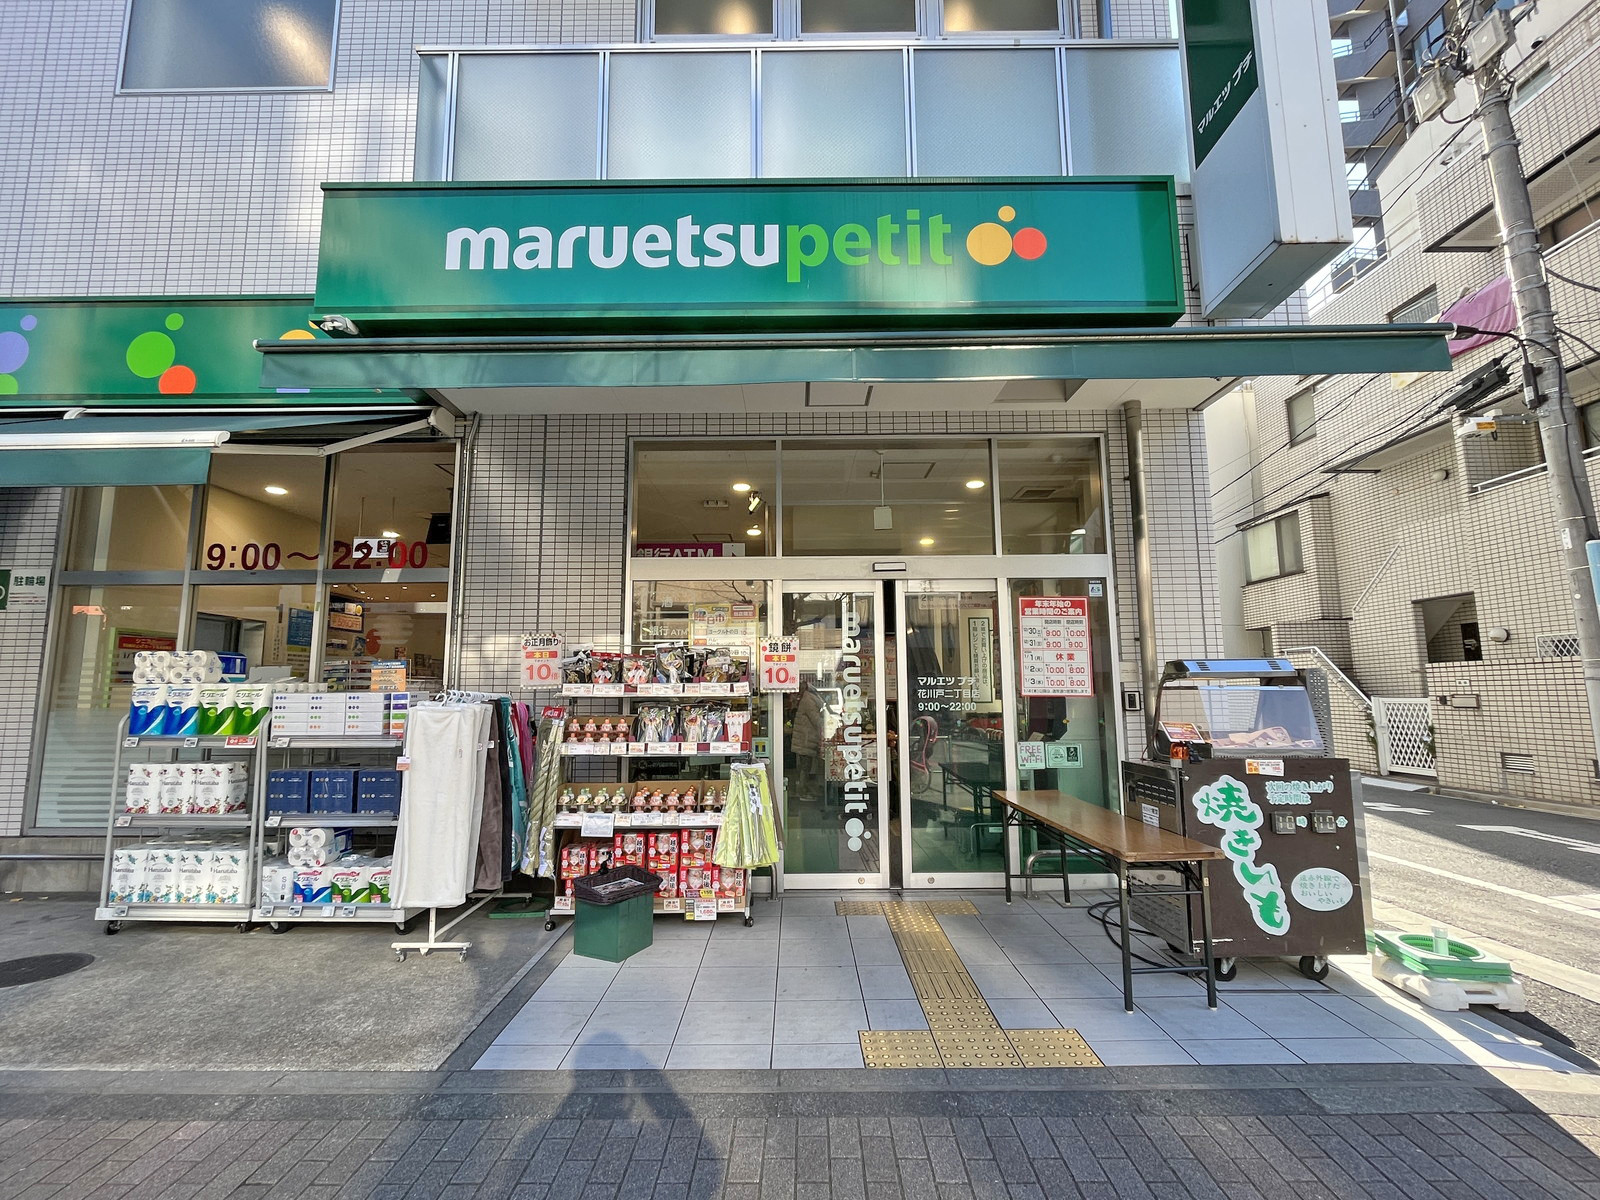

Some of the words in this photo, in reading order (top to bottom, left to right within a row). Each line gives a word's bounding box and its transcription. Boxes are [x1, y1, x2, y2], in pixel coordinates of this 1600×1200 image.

[1197, 81, 1230, 134] マルエツ
[1232, 49, 1253, 87] プチ
[13, 576, 46, 586] 駐輪場
[1034, 600, 1071, 608] 年末年始の
[1024, 608, 1083, 616] 営業時間のご案内
[523, 638, 559, 647] お正月飾り
[1046, 666, 1065, 674] 10:00
[1069, 666, 1085, 674] 8:00
[917, 677, 955, 686] マルエツ
[957, 676, 977, 686] プチ
[1047, 679, 1065, 687] 10:00
[1070, 679, 1086, 687] 8:00
[917, 688, 981, 699] 花川戸二丁目店
[1020, 745, 1042, 753] FREE
[1021, 755, 1042, 763] Wi-Fi
[1267, 781, 1333, 793] 次回の焼き上がり
[1269, 794, 1311, 804] 予定時間は
[1300, 874, 1340, 882] 遠赤外線で
